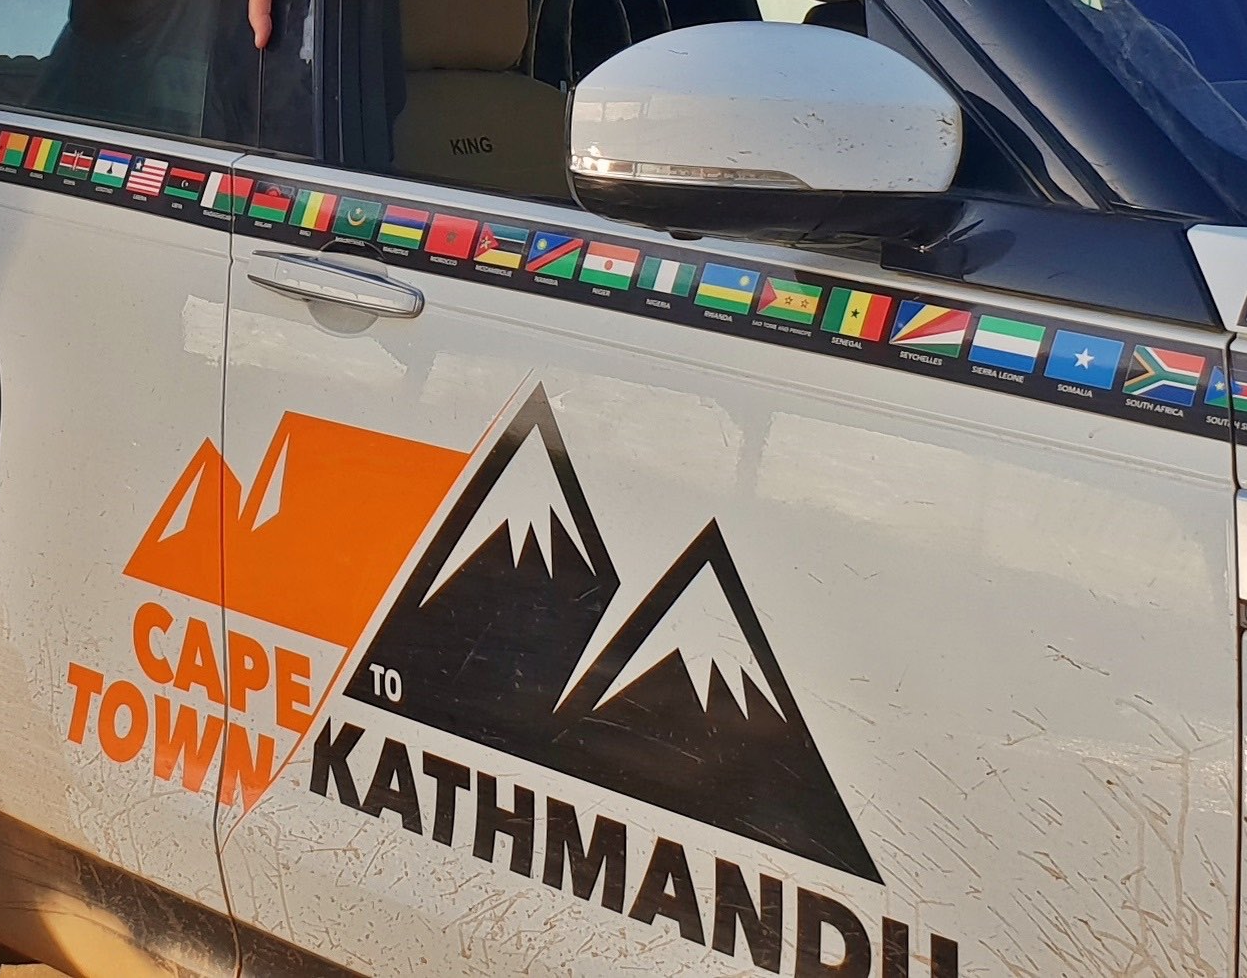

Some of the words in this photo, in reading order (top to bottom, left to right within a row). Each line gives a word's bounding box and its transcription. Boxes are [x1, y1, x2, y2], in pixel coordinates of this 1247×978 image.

[450, 136, 493, 155] KING
[900, 350, 943, 366] SEYCHELLES
[971, 365, 997, 378] SIERRA
[998, 371, 1024, 384] LEONE
[1056, 383, 1093, 398] SOMALIA
[1125, 398, 1152, 411] SOUTH
[1154, 404, 1184, 418] AFRICA
[133, 602, 314, 734] CAPE
[369, 663, 402, 702] TO
[67, 662, 276, 814] TOWN
